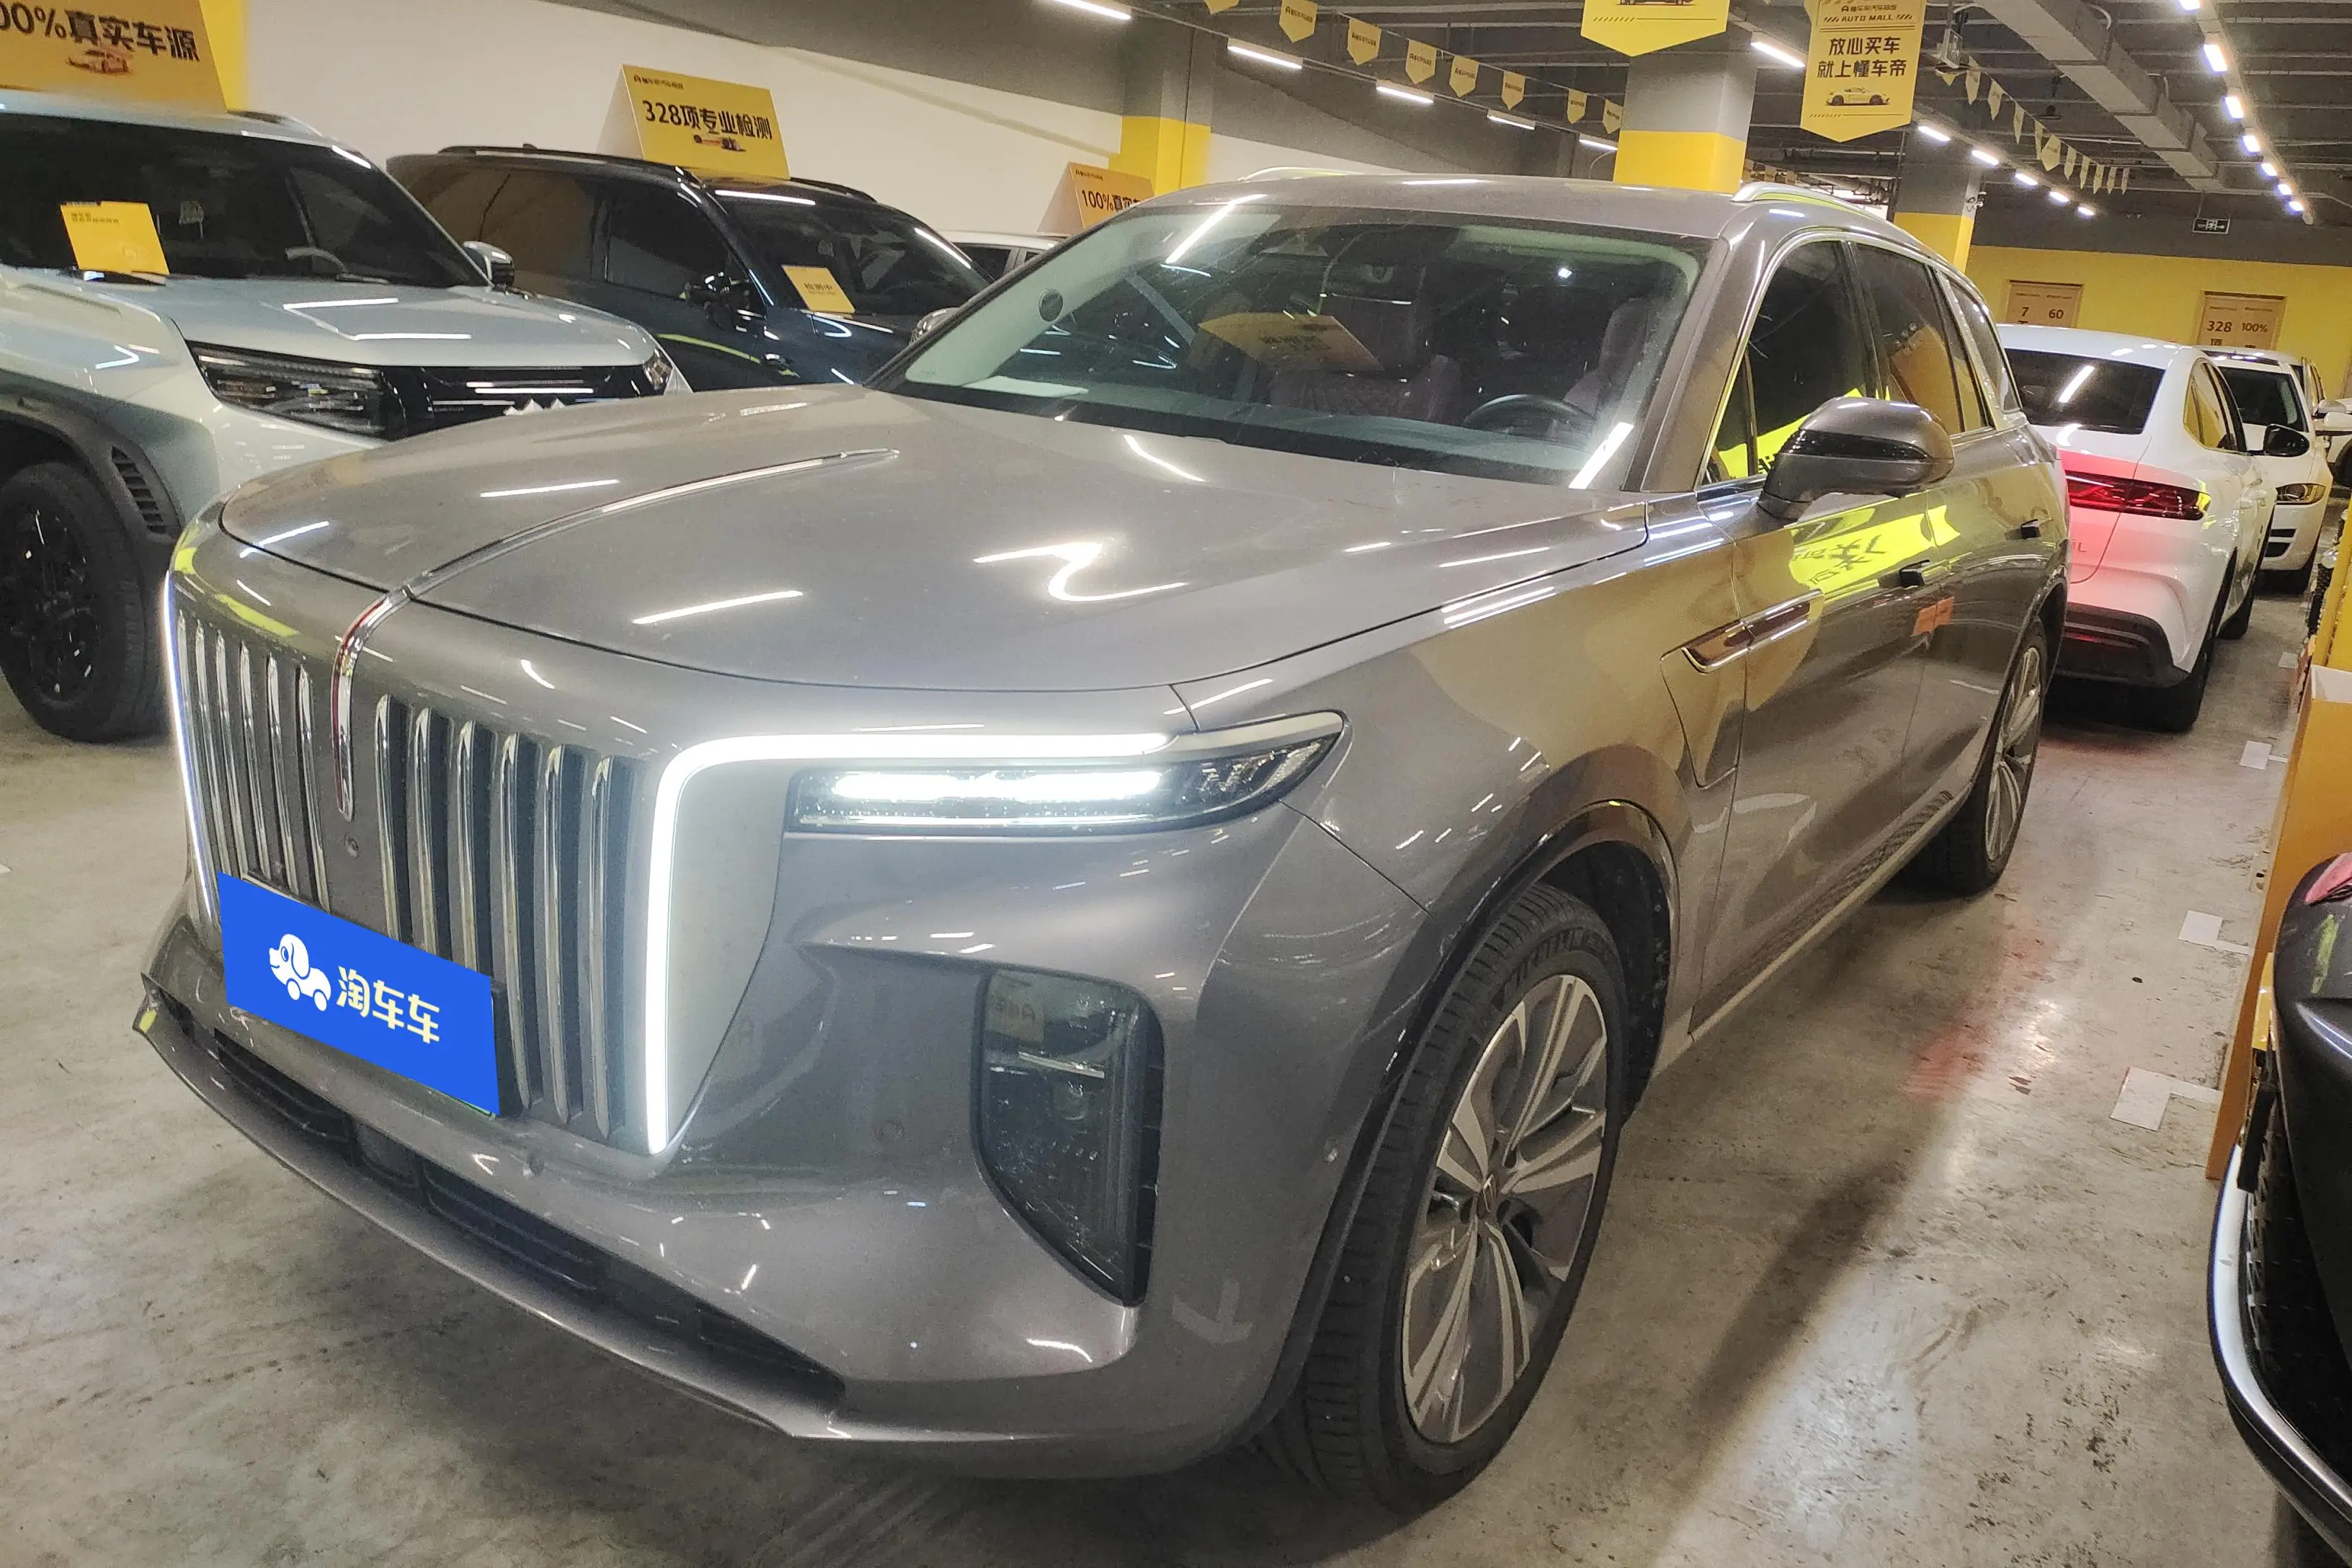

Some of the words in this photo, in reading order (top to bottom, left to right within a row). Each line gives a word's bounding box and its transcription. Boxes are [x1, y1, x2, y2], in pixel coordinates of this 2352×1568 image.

[1829, 37, 1901, 55] 放心买车
[1817, 59, 1907, 78] 就上懂车帝
[643, 99, 772, 140] 328项专业检测
[1082, 190, 1141, 211] 100%真实
[2022, 306, 2029, 317] 7
[2049, 308, 2064, 319] 60
[2206, 321, 2233, 332] 328
[2242, 322, 2268, 333] 100%
